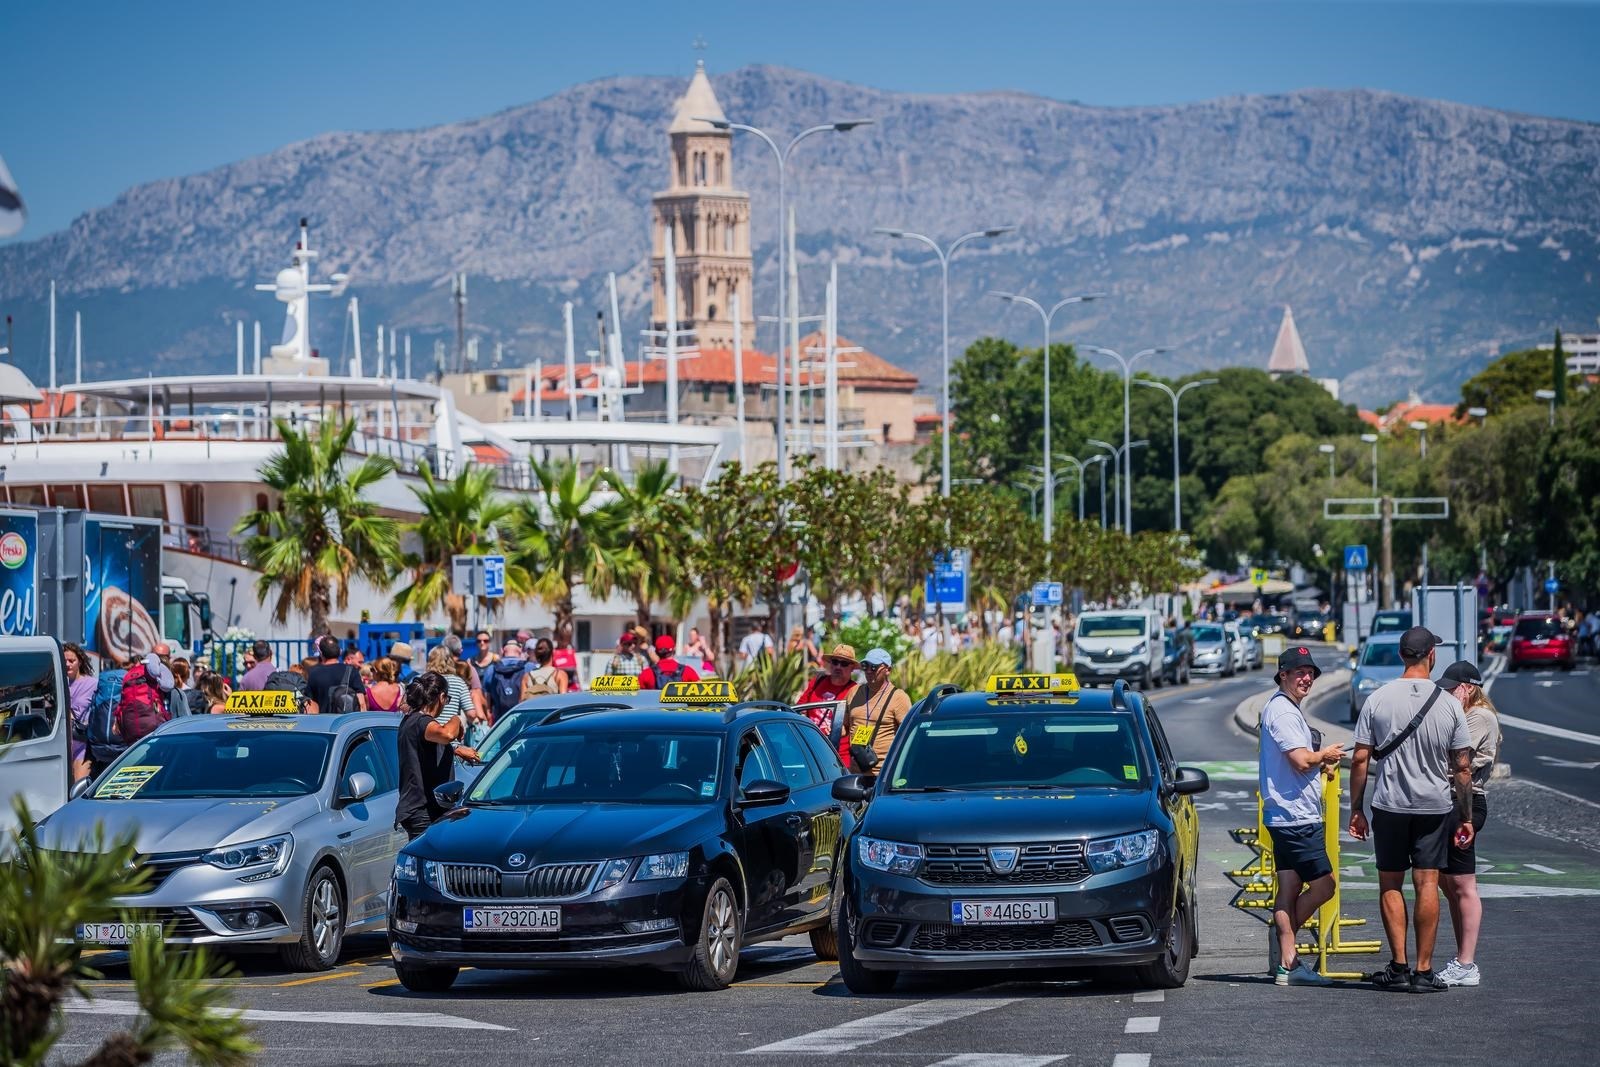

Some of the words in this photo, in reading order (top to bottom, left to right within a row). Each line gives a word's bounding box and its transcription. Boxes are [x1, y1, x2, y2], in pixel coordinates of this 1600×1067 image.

[595, 676, 615, 687] TAXI
[620, 676, 633, 687] 28
[999, 677, 1049, 689] TAXI
[675, 683, 723, 696] TAXI
[231, 694, 264, 708] TAXI
[274, 694, 287, 708] 69
[963, 904, 981, 920] ST
[993, 902, 1049, 919] 4466-U
[474, 911, 491, 927] ST
[501, 911, 558, 927] 2920-AB
[85, 924, 100, 939] ST
